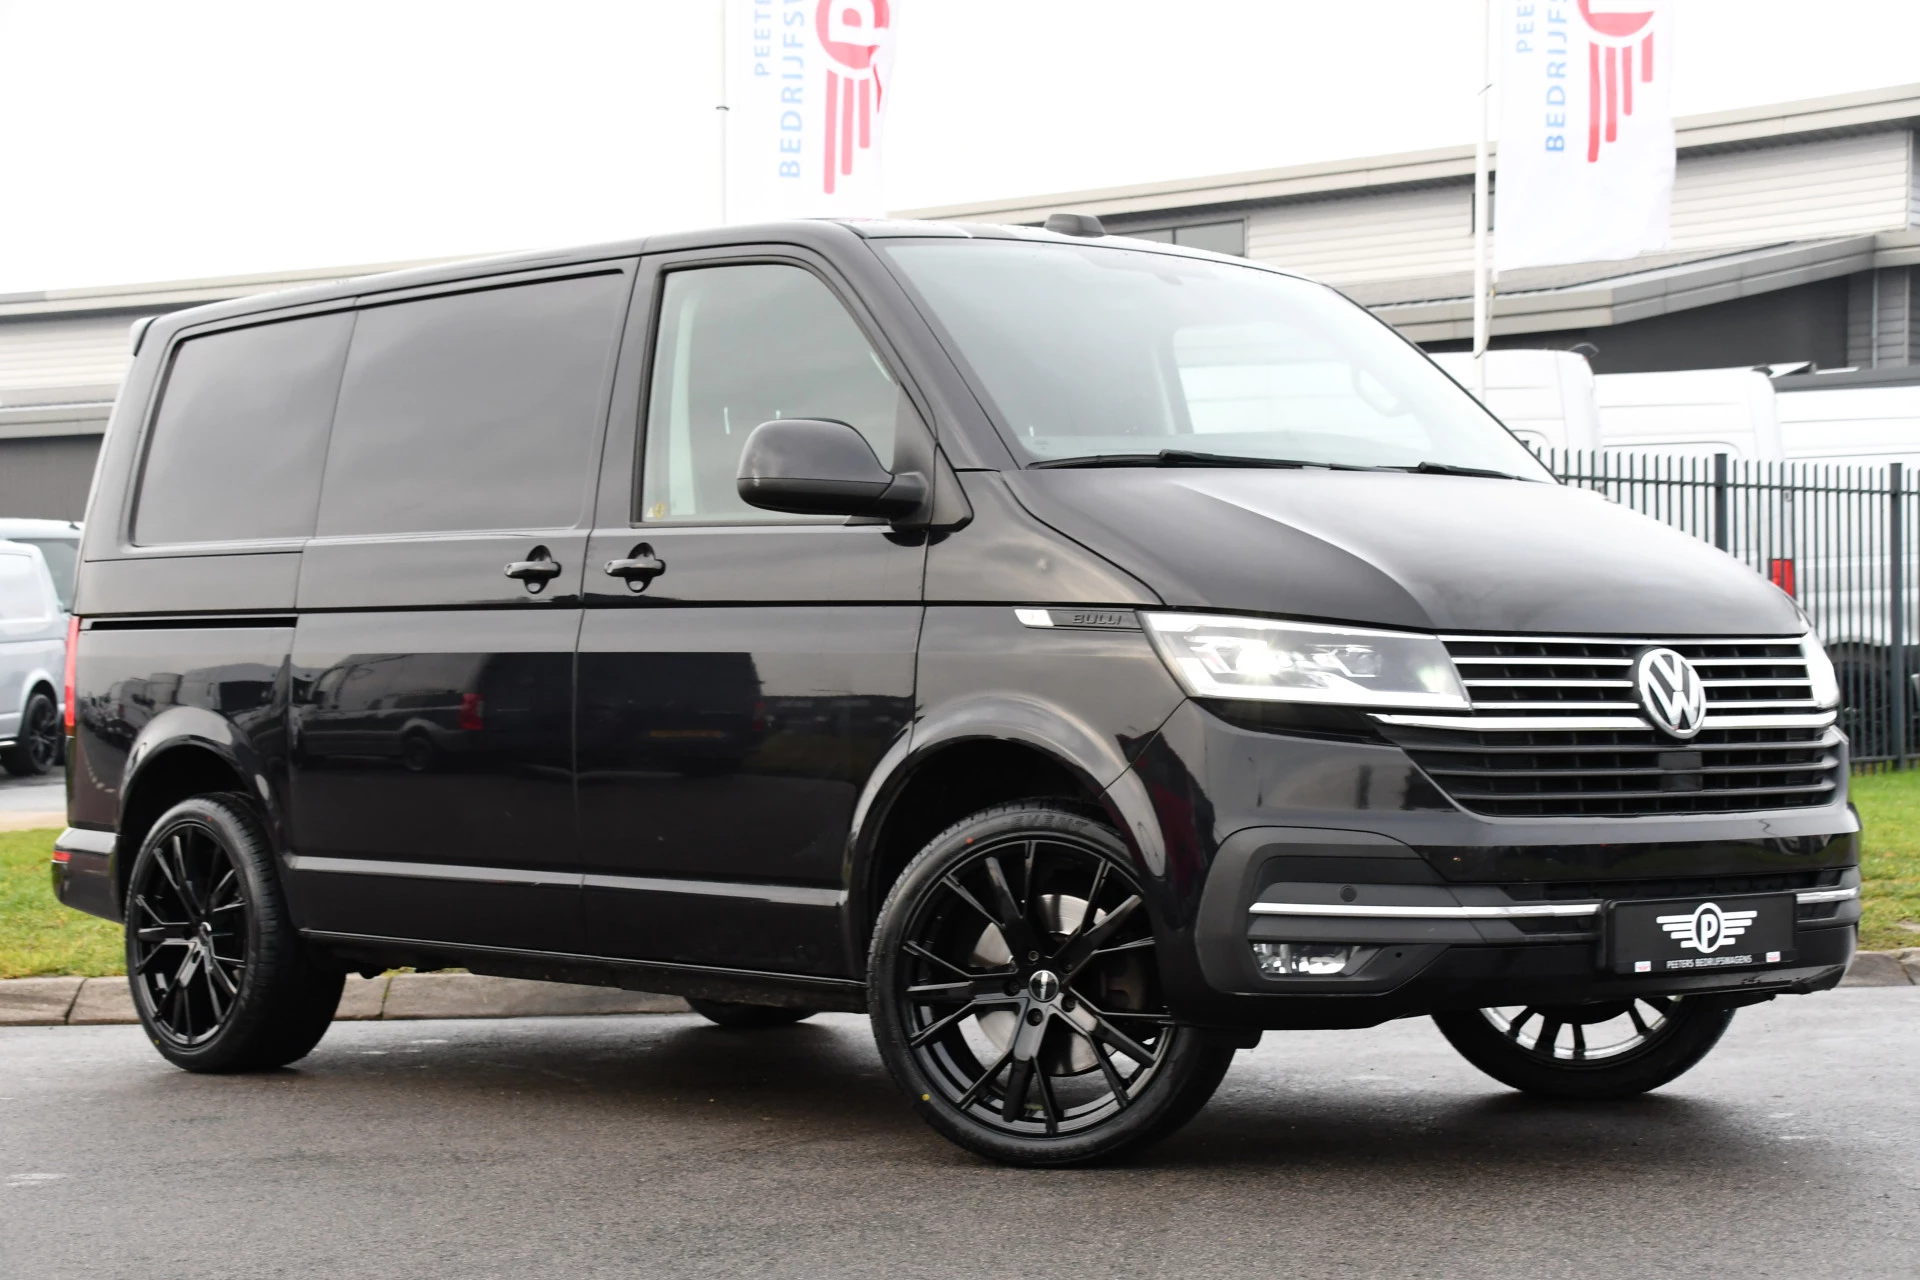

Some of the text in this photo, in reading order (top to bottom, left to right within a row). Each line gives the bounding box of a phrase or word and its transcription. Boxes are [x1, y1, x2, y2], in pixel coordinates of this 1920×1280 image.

[1516, 0, 1534, 53] PEE
[779, 0, 805, 178] BEDRIJFS
[1544, 0, 1568, 153] BEDRIJF
[1072, 614, 1122, 625] BULLI
[1666, 959, 1694, 969] PEETERS
